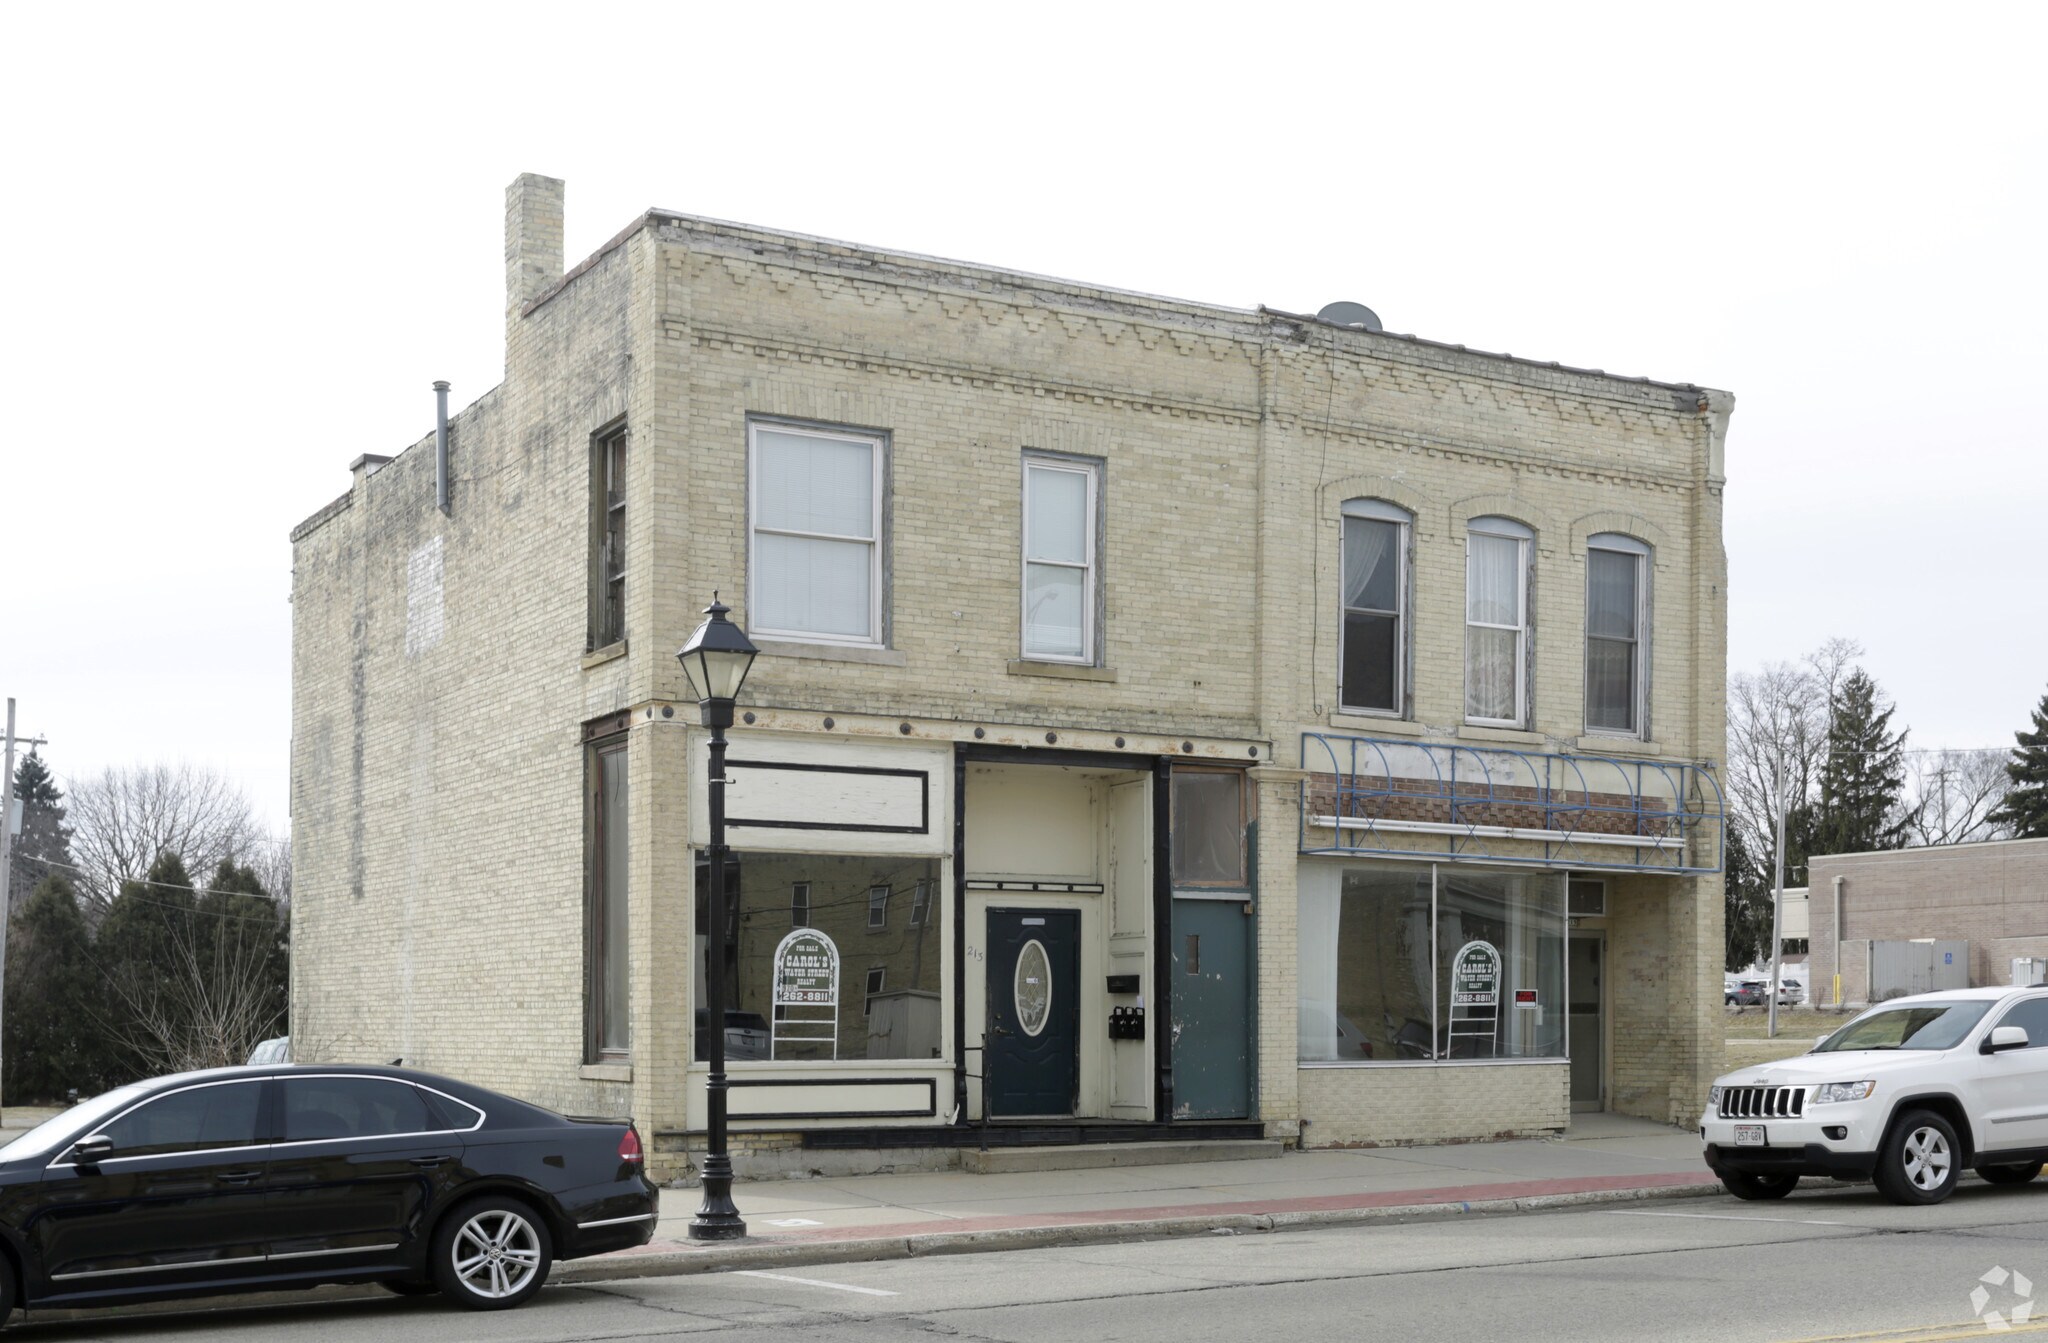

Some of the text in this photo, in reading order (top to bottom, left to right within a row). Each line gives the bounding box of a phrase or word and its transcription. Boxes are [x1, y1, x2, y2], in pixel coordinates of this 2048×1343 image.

[786, 955, 828, 968] CAROL'S
[784, 968, 830, 978] WATER STREET
[1462, 963, 1492, 973] CAROL'S
[797, 978, 816, 986] REALTY
